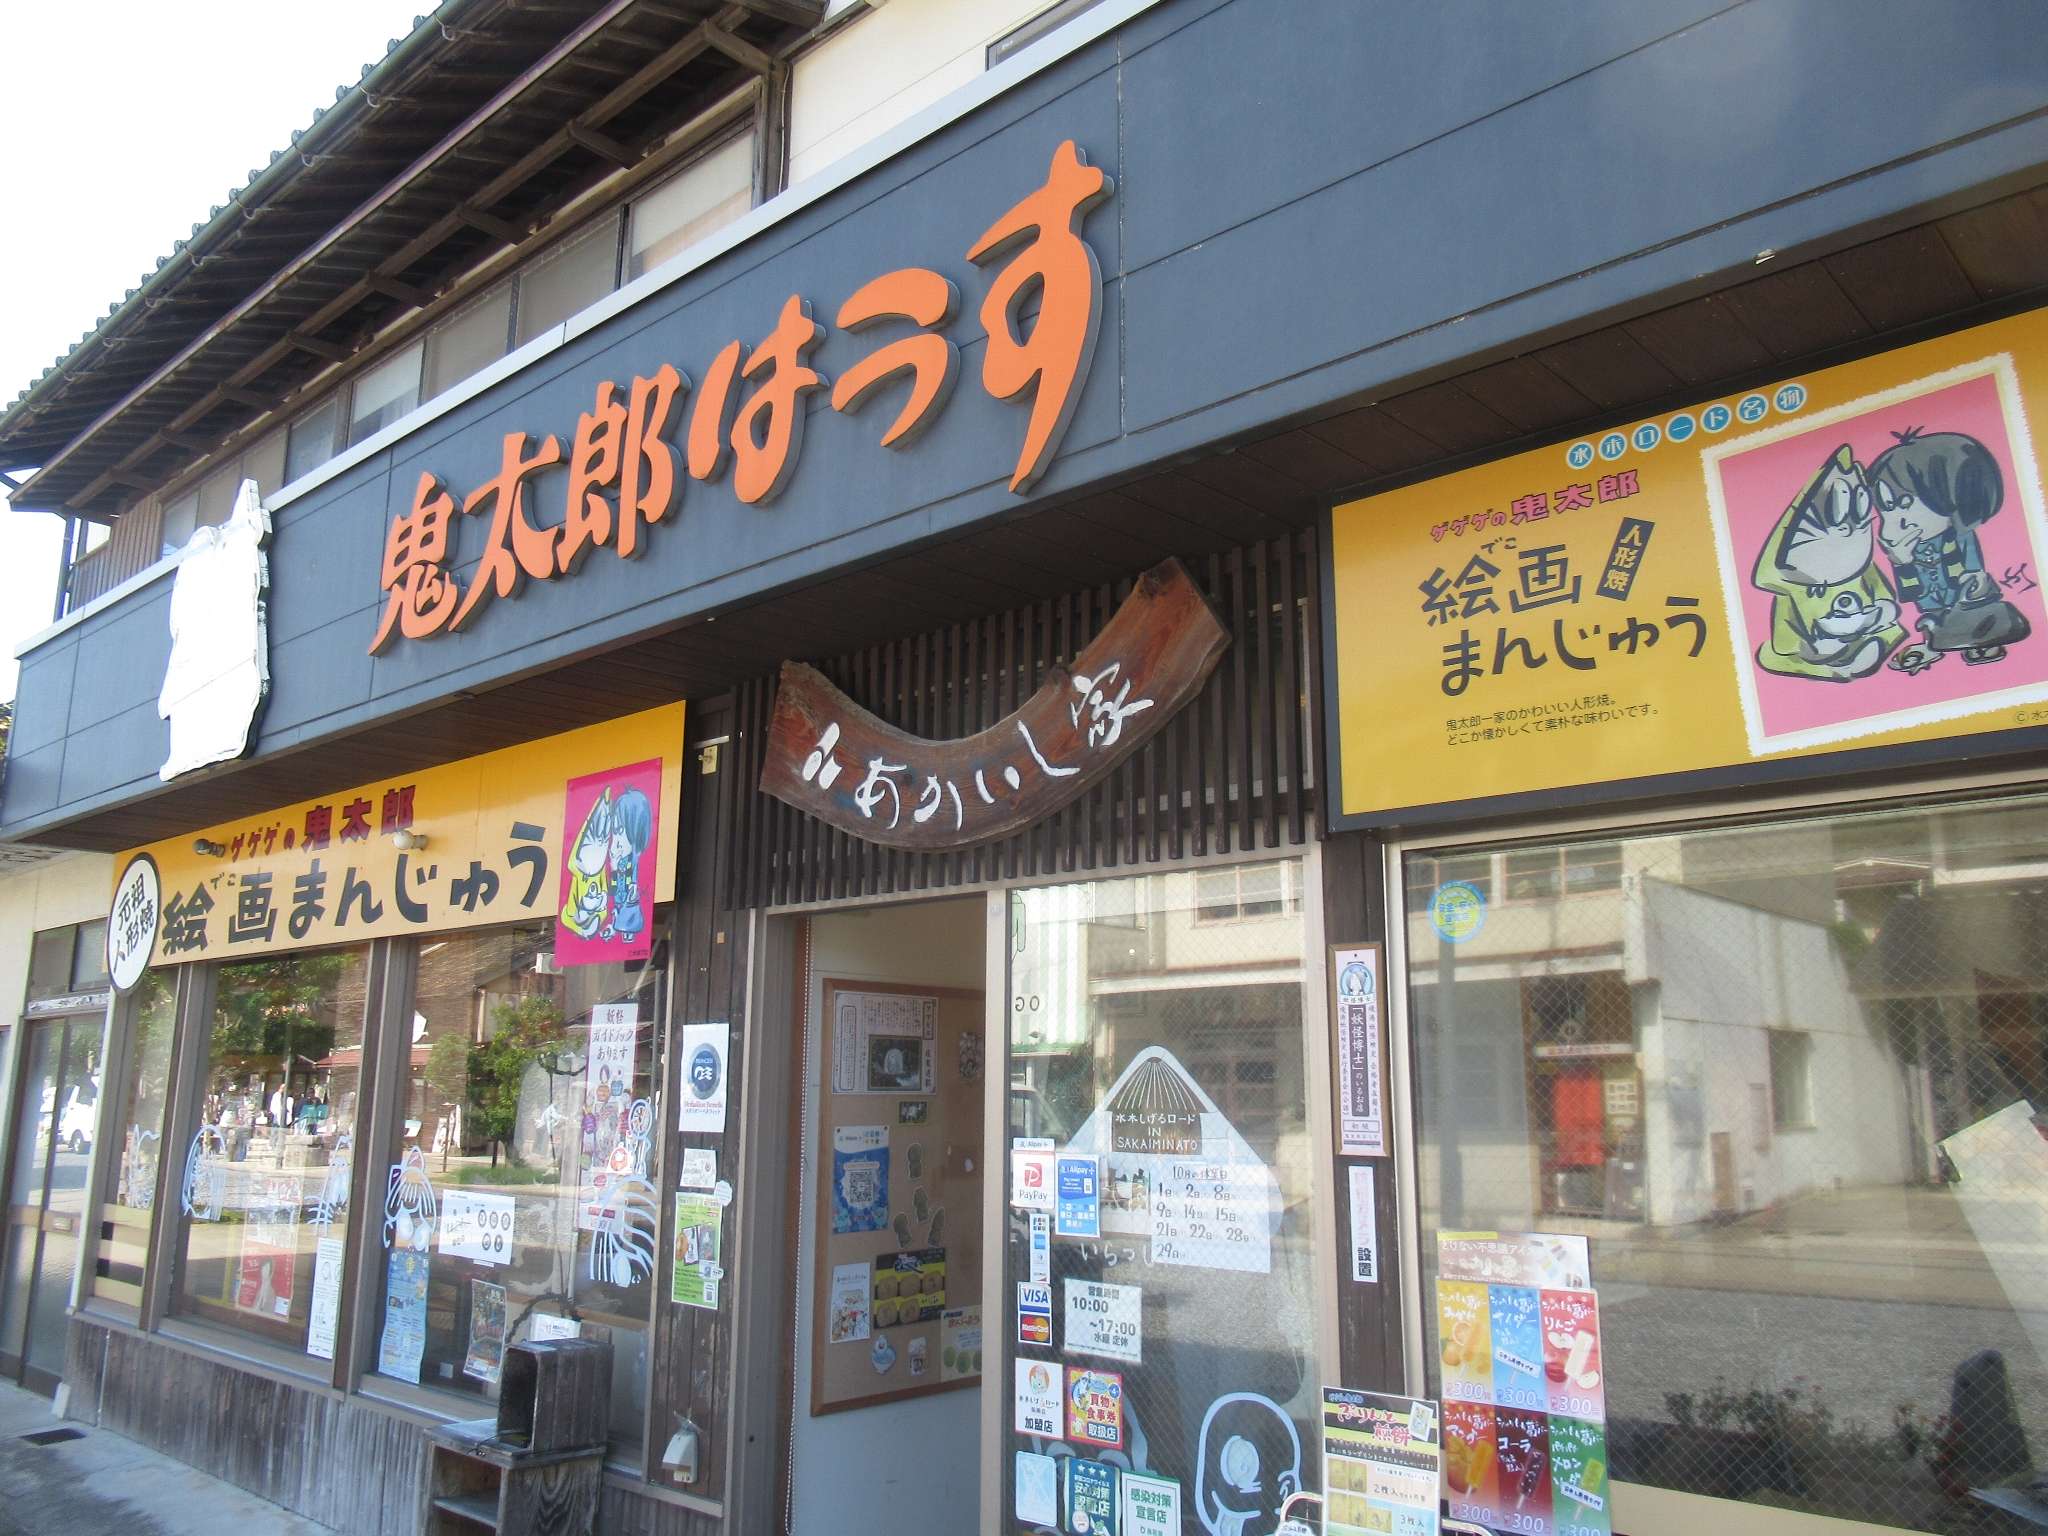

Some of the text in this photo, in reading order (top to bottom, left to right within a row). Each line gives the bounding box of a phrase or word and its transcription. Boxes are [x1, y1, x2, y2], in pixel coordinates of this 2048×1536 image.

[369, 139, 1108, 657] 鬼太郎はうす
[1570, 385, 1805, 466] 水木ロード名物
[1430, 469, 1641, 543] ゲゲゲの鬼太郎
[1603, 524, 1646, 594] 人形焼
[1418, 543, 1583, 627] 絵画
[1441, 596, 1706, 697] まんじゅう
[230, 784, 417, 863] ゲゲゲの鬼太郎
[161, 821, 549, 956] 絵画まんじゅう
[118, 872, 147, 931] 元祖
[1115, 1112, 1196, 1125] 水木しげるロード
[1148, 1126, 1161, 1137] IN
[1117, 1136, 1198, 1151] SAKAIMINATO
[1019, 1189, 1048, 1201] PayPay
[1023, 1289, 1049, 1303] VISA
[1072, 1296, 1109, 1313] 10:00
[1544, 1316, 1576, 1331] りんご
[1560, 1395, 1592, 1413] 300
[1025, 1416, 1053, 1433] 加盟店
[1088, 1423, 1116, 1440] 取扱店
[1498, 1437, 1531, 1453] コーラ
[1552, 1456, 1581, 1472] メロン
[1131, 1487, 1172, 1507] 感染対策
[1135, 1505, 1167, 1523] 宣言店
[1513, 1513, 1544, 1532] 300
